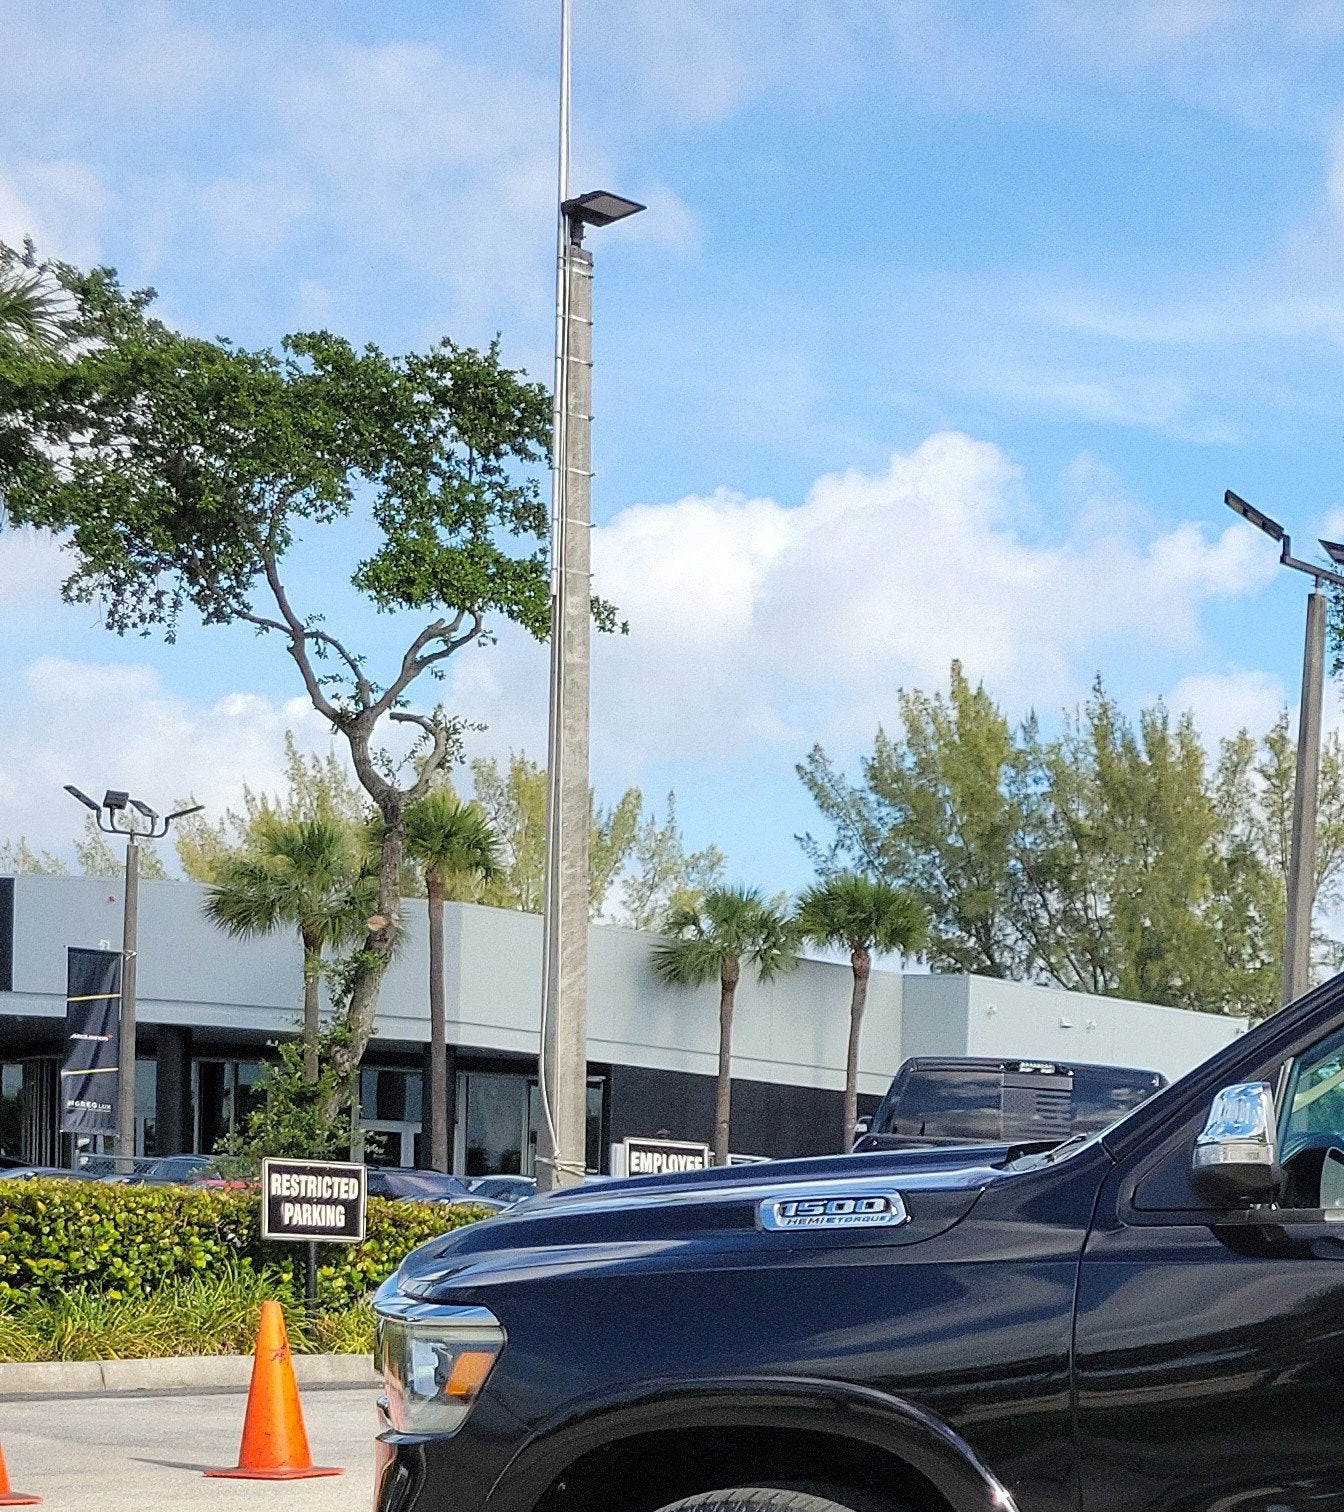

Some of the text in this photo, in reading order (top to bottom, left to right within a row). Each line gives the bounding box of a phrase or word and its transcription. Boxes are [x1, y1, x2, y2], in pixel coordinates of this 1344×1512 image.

[631, 1151, 703, 1174] EMPLOYEE
[271, 1173, 359, 1200] RESTRICTED
[283, 1202, 346, 1228] PARKING
[783, 1199, 886, 1216] 1500
[786, 1216, 824, 1225] HEMI
